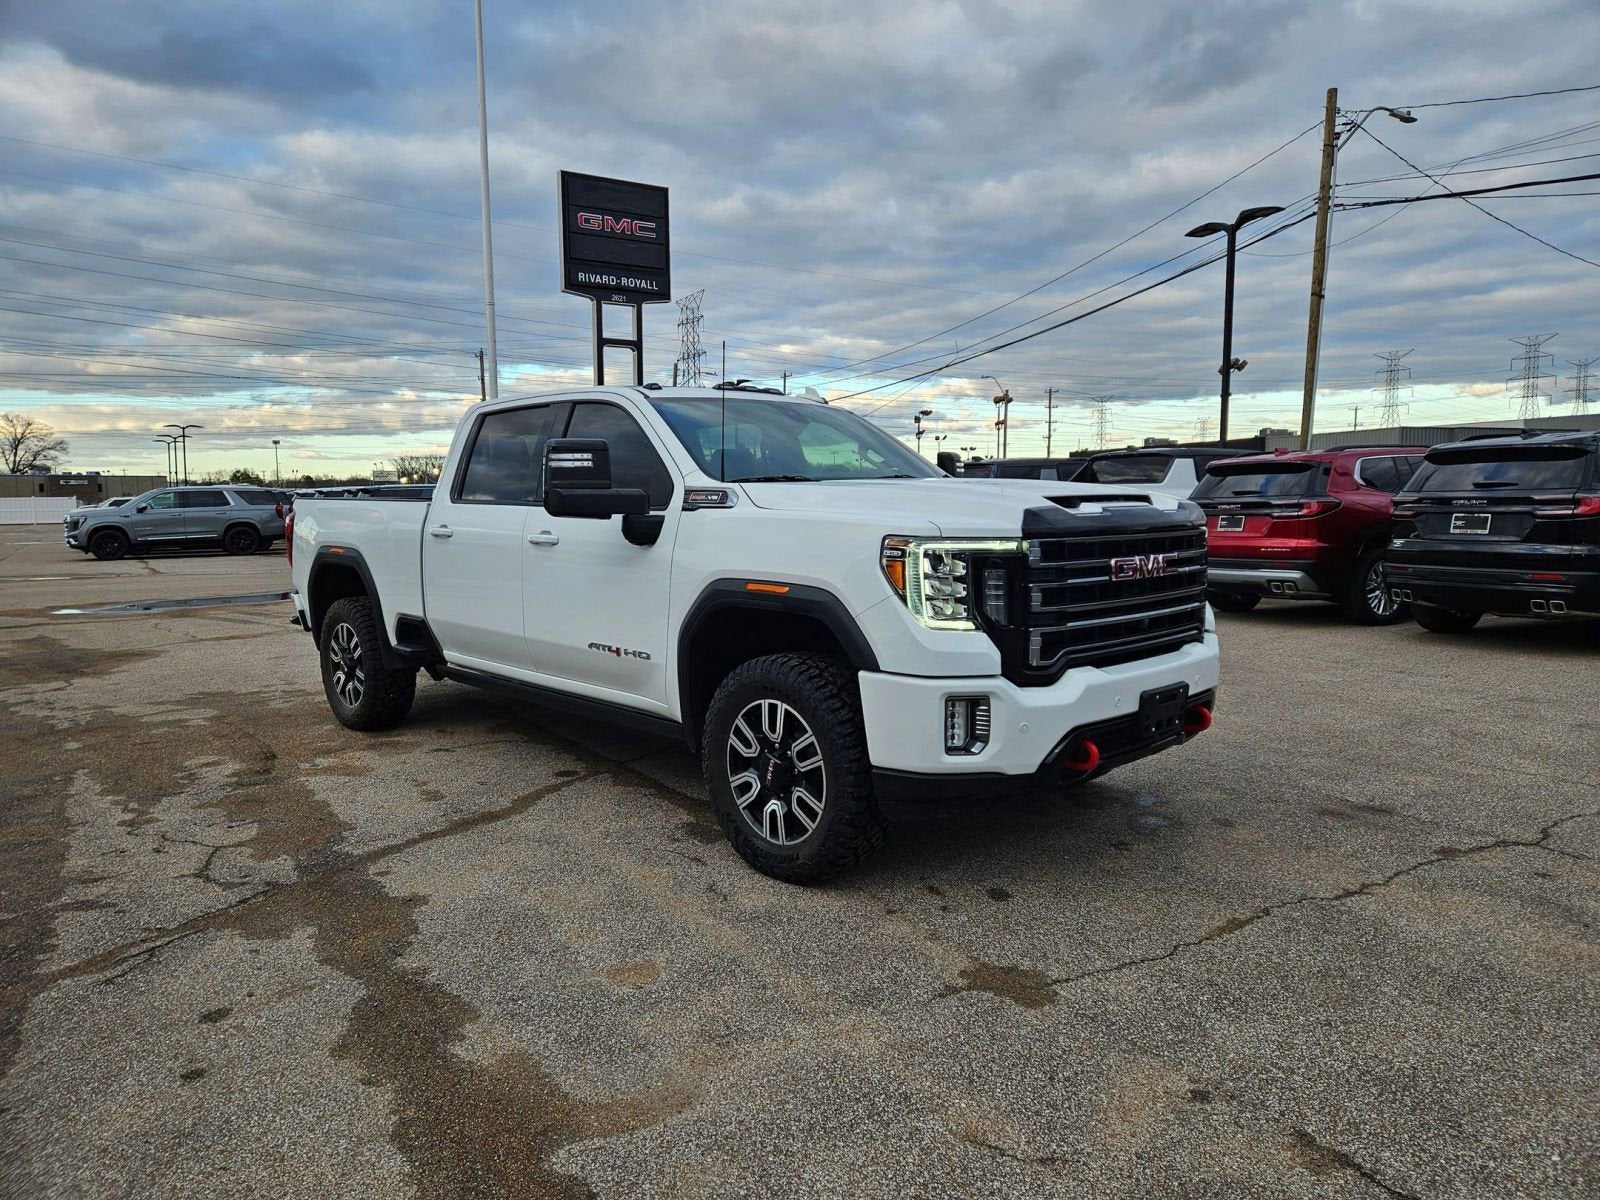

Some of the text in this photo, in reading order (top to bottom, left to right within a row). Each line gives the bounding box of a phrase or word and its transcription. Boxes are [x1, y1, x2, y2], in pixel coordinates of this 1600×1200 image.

[577, 212, 656, 238] GMC
[578, 272, 659, 290] RIVARD-ROYALL
[611, 294, 627, 302] 2621
[1110, 552, 1178, 581] GMC
[588, 642, 652, 661] AT4 HD
